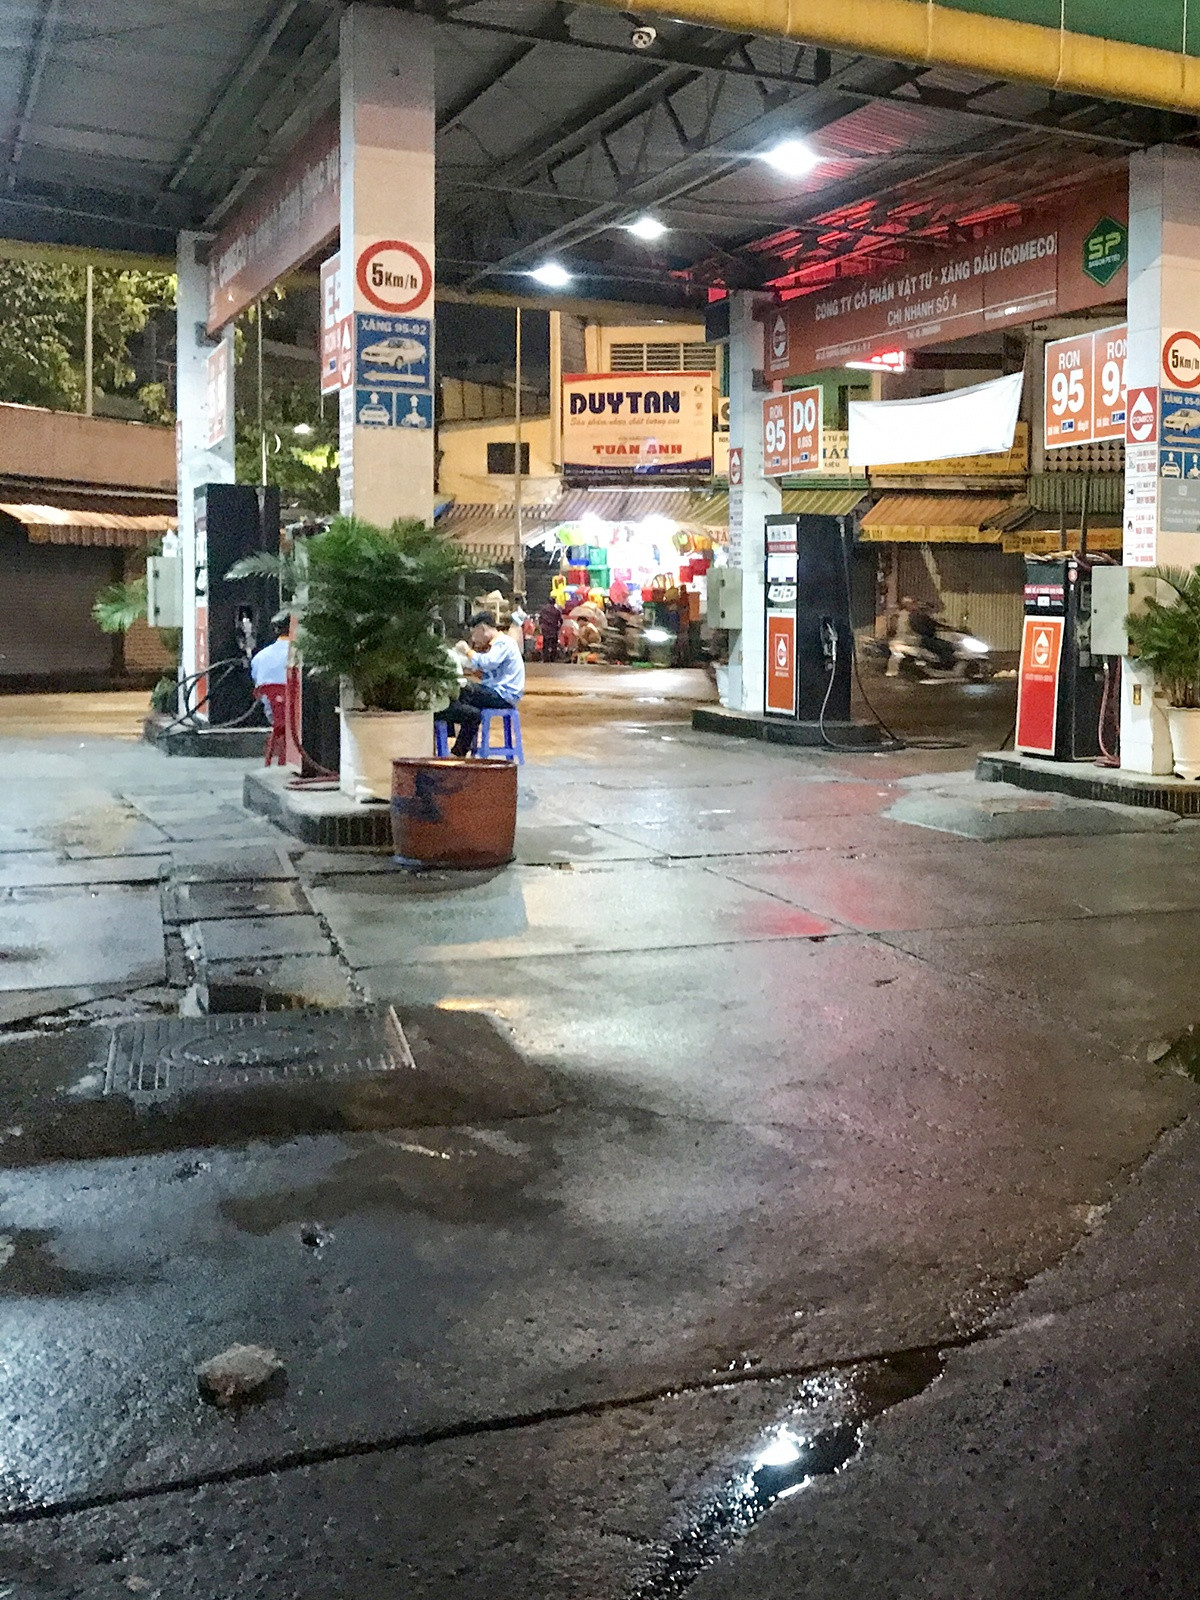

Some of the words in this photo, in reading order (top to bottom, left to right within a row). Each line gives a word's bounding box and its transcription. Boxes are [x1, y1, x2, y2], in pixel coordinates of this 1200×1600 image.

[1088, 231, 1121, 260] SP
[840, 295, 853, 313] TY
[951, 293, 958, 309] 4
[1058, 349, 1080, 370] RON
[1051, 368, 1085, 416] 95
[793, 397, 816, 434] DO
[765, 418, 786, 453] 95
[646, 444, 682, 455] ANH
